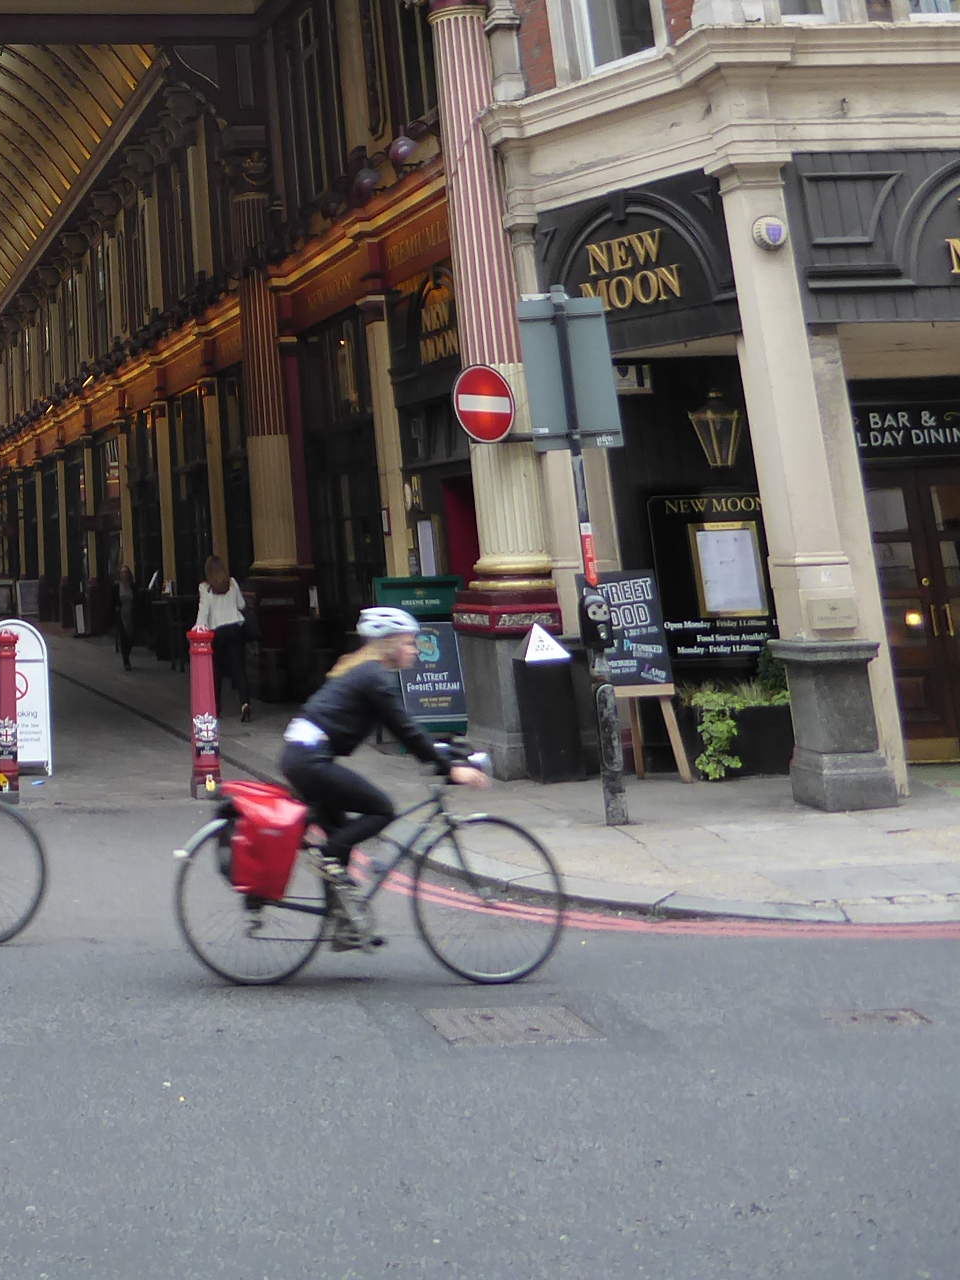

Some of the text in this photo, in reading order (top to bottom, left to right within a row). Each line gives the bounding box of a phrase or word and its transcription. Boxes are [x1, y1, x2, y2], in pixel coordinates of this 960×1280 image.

[586, 228, 662, 276] NEW
[579, 263, 682, 312] MOON
[421, 301, 450, 334] NEW
[868, 410, 937, 429] BAR &
[856, 427, 960, 448] LDAY DININ
[665, 498, 708, 514] NEW
[583, 577, 654, 604] TREET
[610, 603, 651, 629] OOD
[663, 621, 683, 631] Open
[416, 671, 449, 682] A STREET
[406, 681, 433, 693] FOODIES
[17, 709, 38, 719] oking
